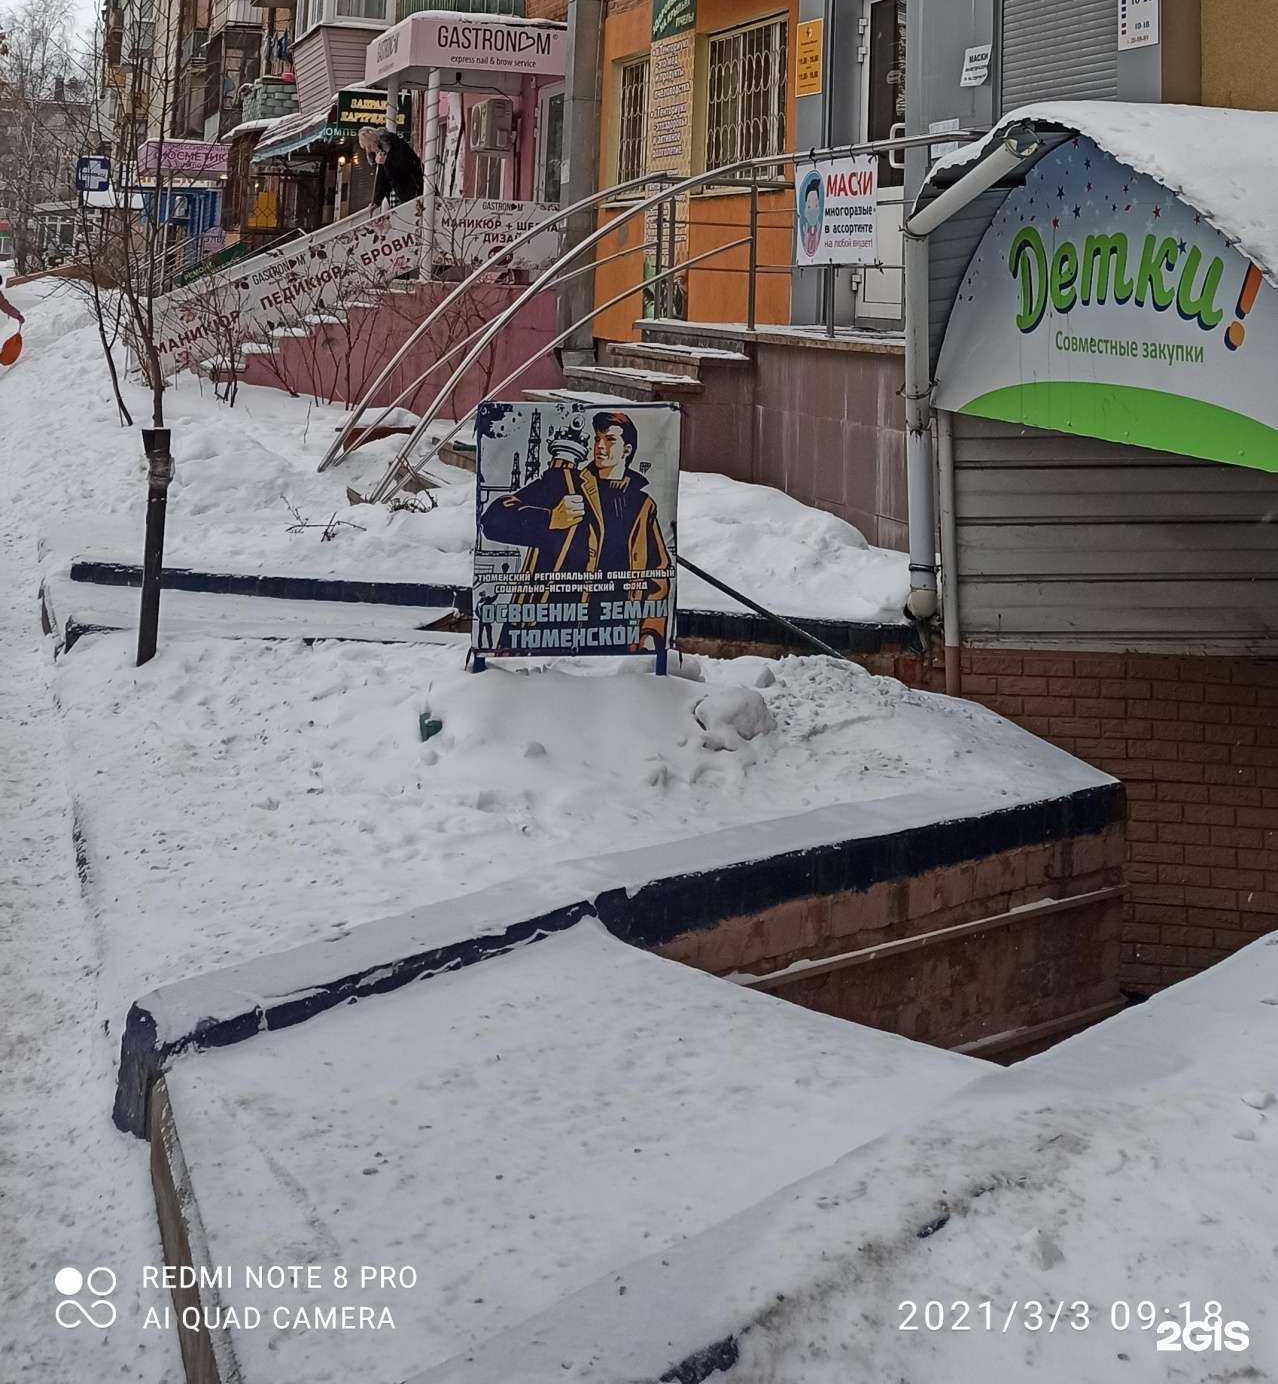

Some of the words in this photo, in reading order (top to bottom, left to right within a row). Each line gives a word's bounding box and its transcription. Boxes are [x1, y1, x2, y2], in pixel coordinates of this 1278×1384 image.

[451, 56, 475, 64] express
[496, 58, 512, 66] brow
[514, 60, 536, 68] service
[162, 151, 226, 162] КОСМЕТИК
[442, 217, 502, 229] МАНИКЮР
[825, 225, 830, 233] в
[360, 232, 415, 266] БРОВИ
[260, 266, 343, 310] ПЕДИКЮР
[1009, 226, 1263, 351] Детки!
[1055, 330, 1138, 357] Совместные
[1142, 342, 1204, 366] закупки
[478, 571, 531, 582] ТЮМЕНСКИЙ
[534, 569, 603, 581] РЕГИОНАЛЬНЫЙ
[607, 567, 675, 580] ОБЩЕСТВЕННЫЙ
[496, 580, 615, 593] СОЦИАЛЬНО-ИСТОРИЧЕСКИЙ
[623, 581, 648, 590] ФОНД
[481, 603, 589, 623] ОСВОЕНИЕ
[600, 600, 668, 620] ЗЕМЛИ
[509, 621, 640, 648] ТЮМЕНСКОЙ
